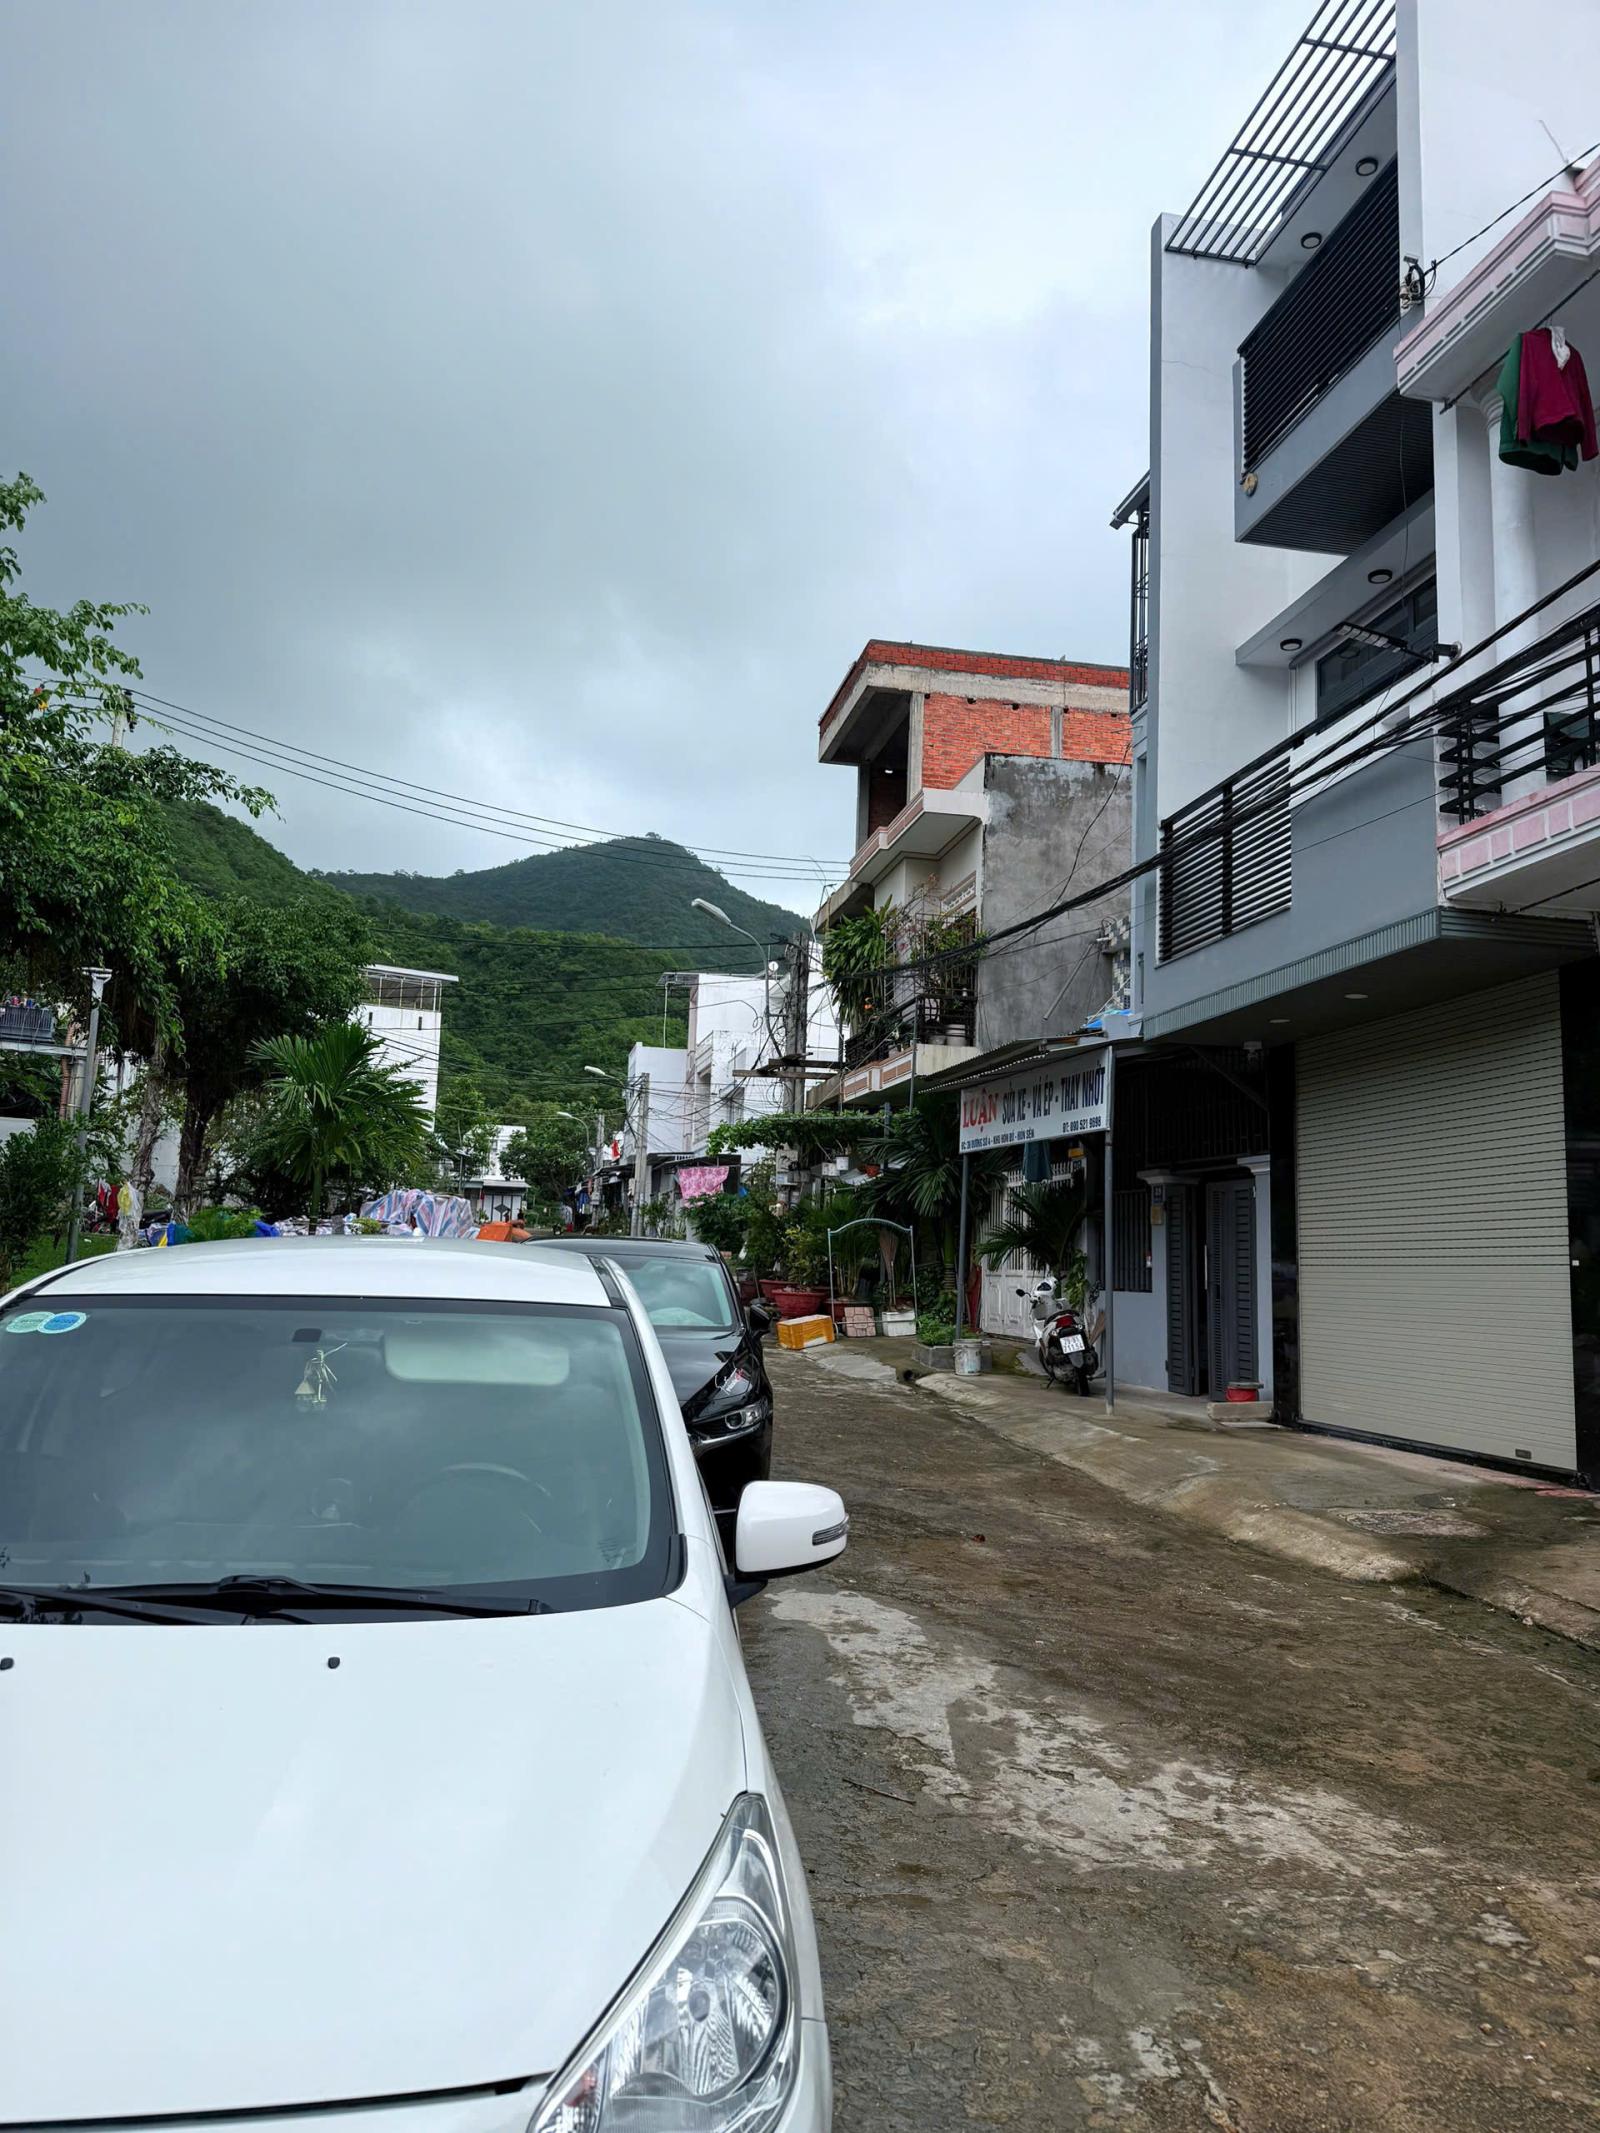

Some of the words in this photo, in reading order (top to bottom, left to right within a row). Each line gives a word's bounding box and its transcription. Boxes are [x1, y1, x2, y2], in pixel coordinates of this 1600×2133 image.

[963, 1087, 999, 1132] LUẬN
[1002, 1080, 1016, 1125] SỬA
[1017, 1088, 1026, 1121] XE
[1061, 1073, 1080, 1113] THAY
